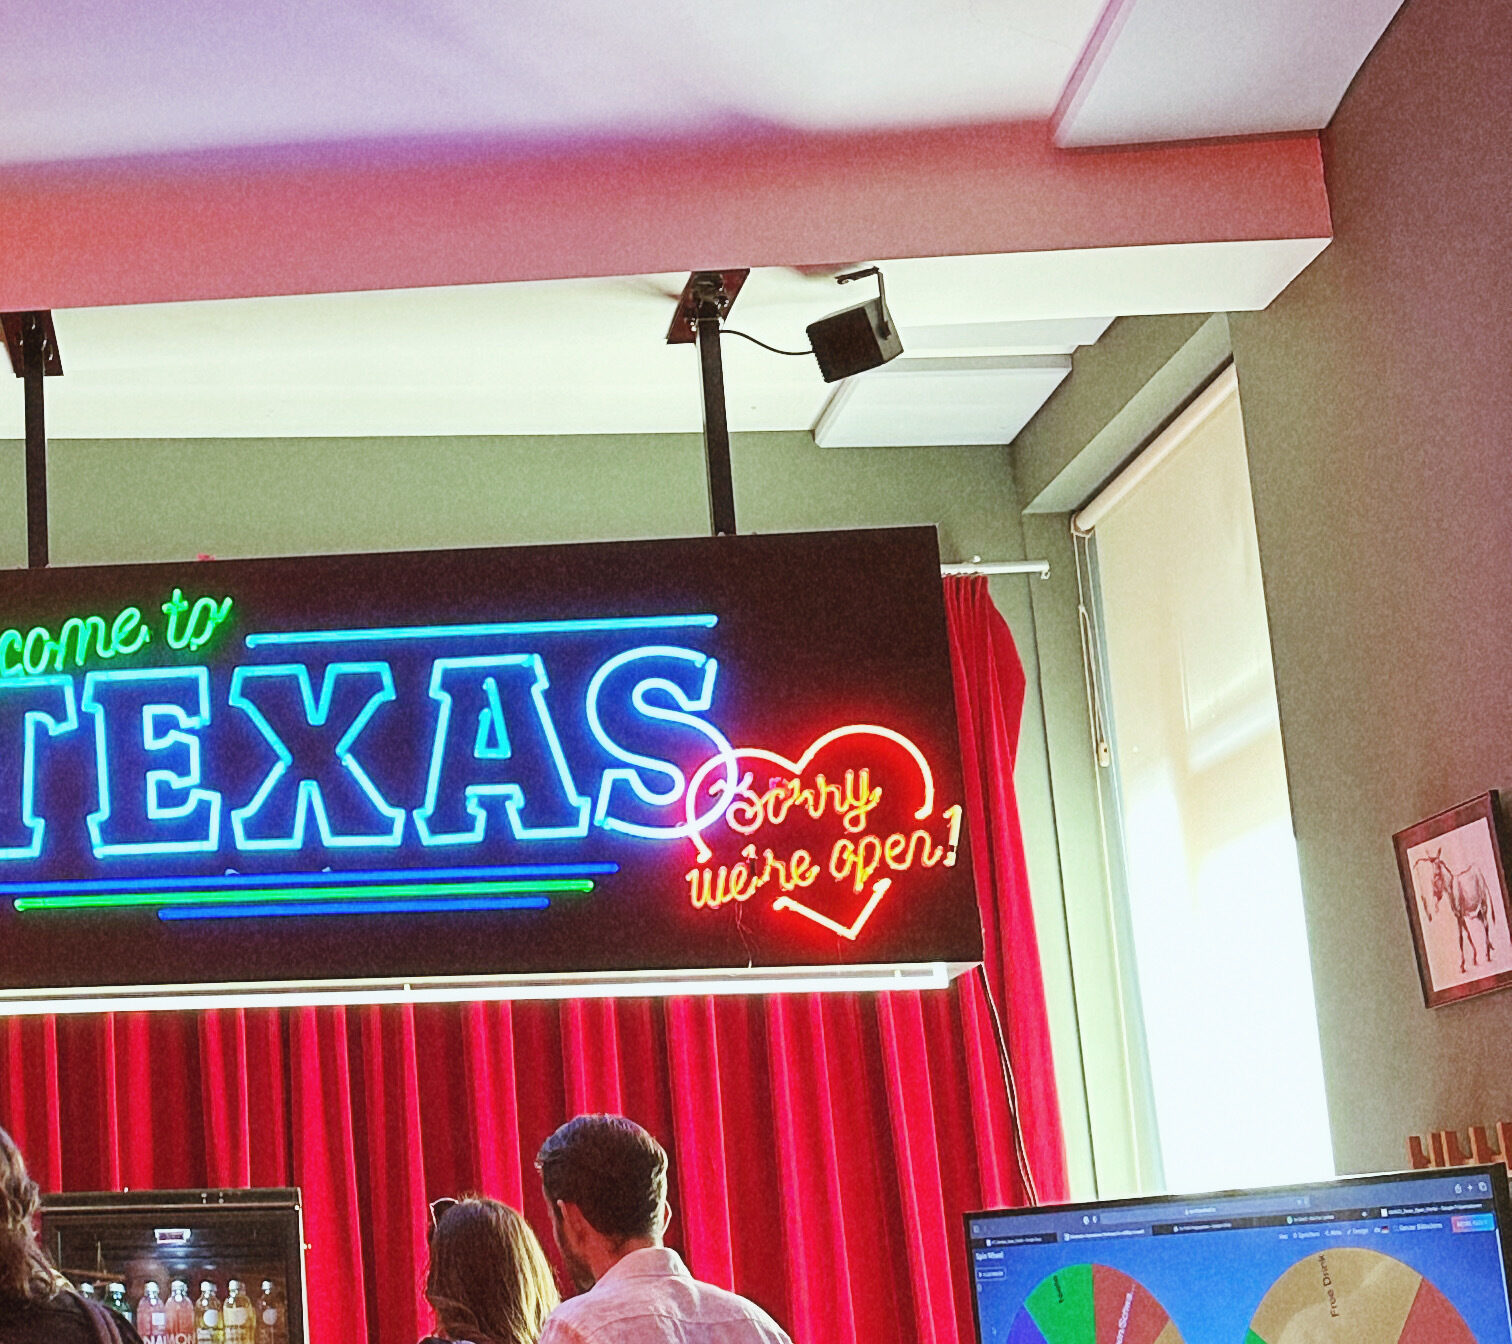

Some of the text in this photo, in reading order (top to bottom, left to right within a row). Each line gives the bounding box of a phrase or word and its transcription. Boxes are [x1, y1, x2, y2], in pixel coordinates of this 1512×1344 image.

[162, 588, 232, 651] to
[709, 768, 883, 834] Sorry
[686, 804, 963, 909] we're open!
[1319, 1254, 1340, 1318] Free Drink
